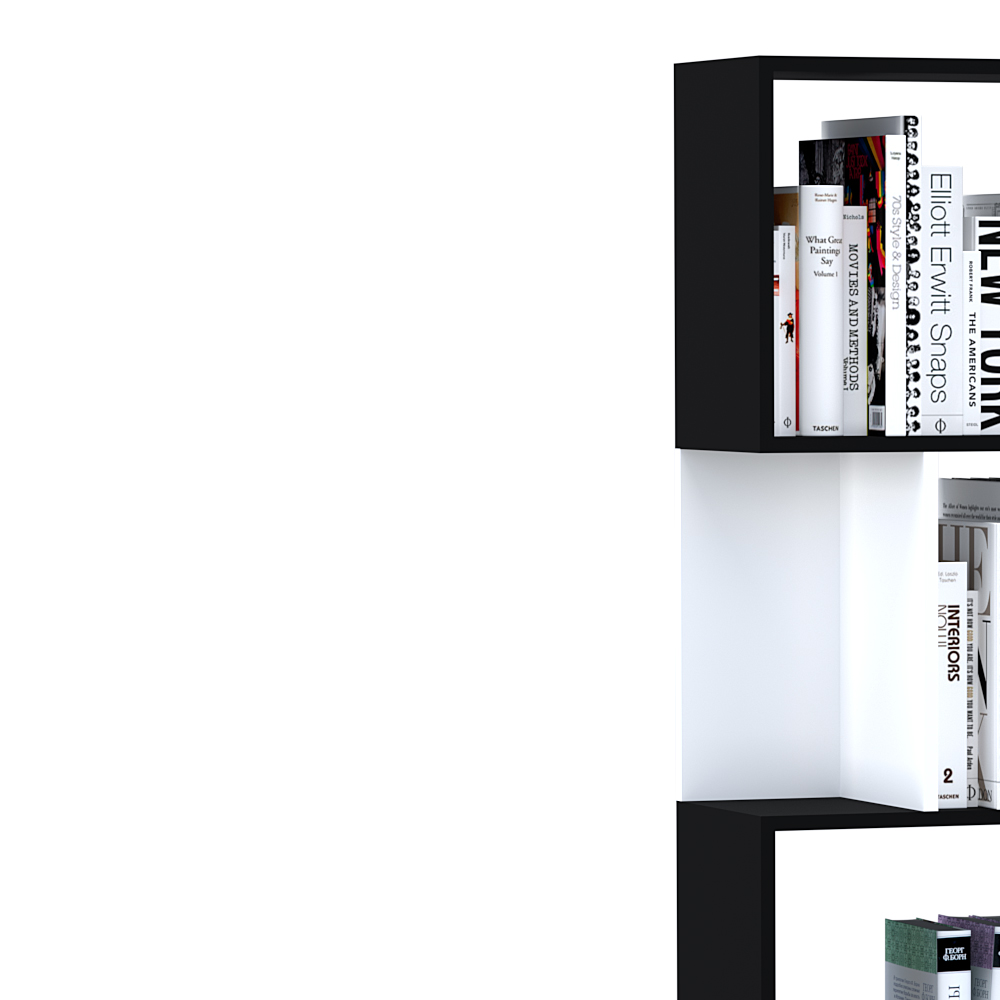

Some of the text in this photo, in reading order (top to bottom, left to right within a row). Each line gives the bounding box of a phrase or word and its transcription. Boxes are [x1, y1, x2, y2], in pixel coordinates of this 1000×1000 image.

[806, 236, 827, 244] What
[821, 258, 834, 267] Say
[890, 195, 901, 310] 70s Style & Design
[925, 173, 953, 403] Elliott Erwitt Snaps
[849, 243, 860, 391] MOVIES AND METHODS
[948, 604, 960, 682] INTERIORS
[943, 768, 953, 784] 2
[945, 946, 965, 954] ГЕОРГ
